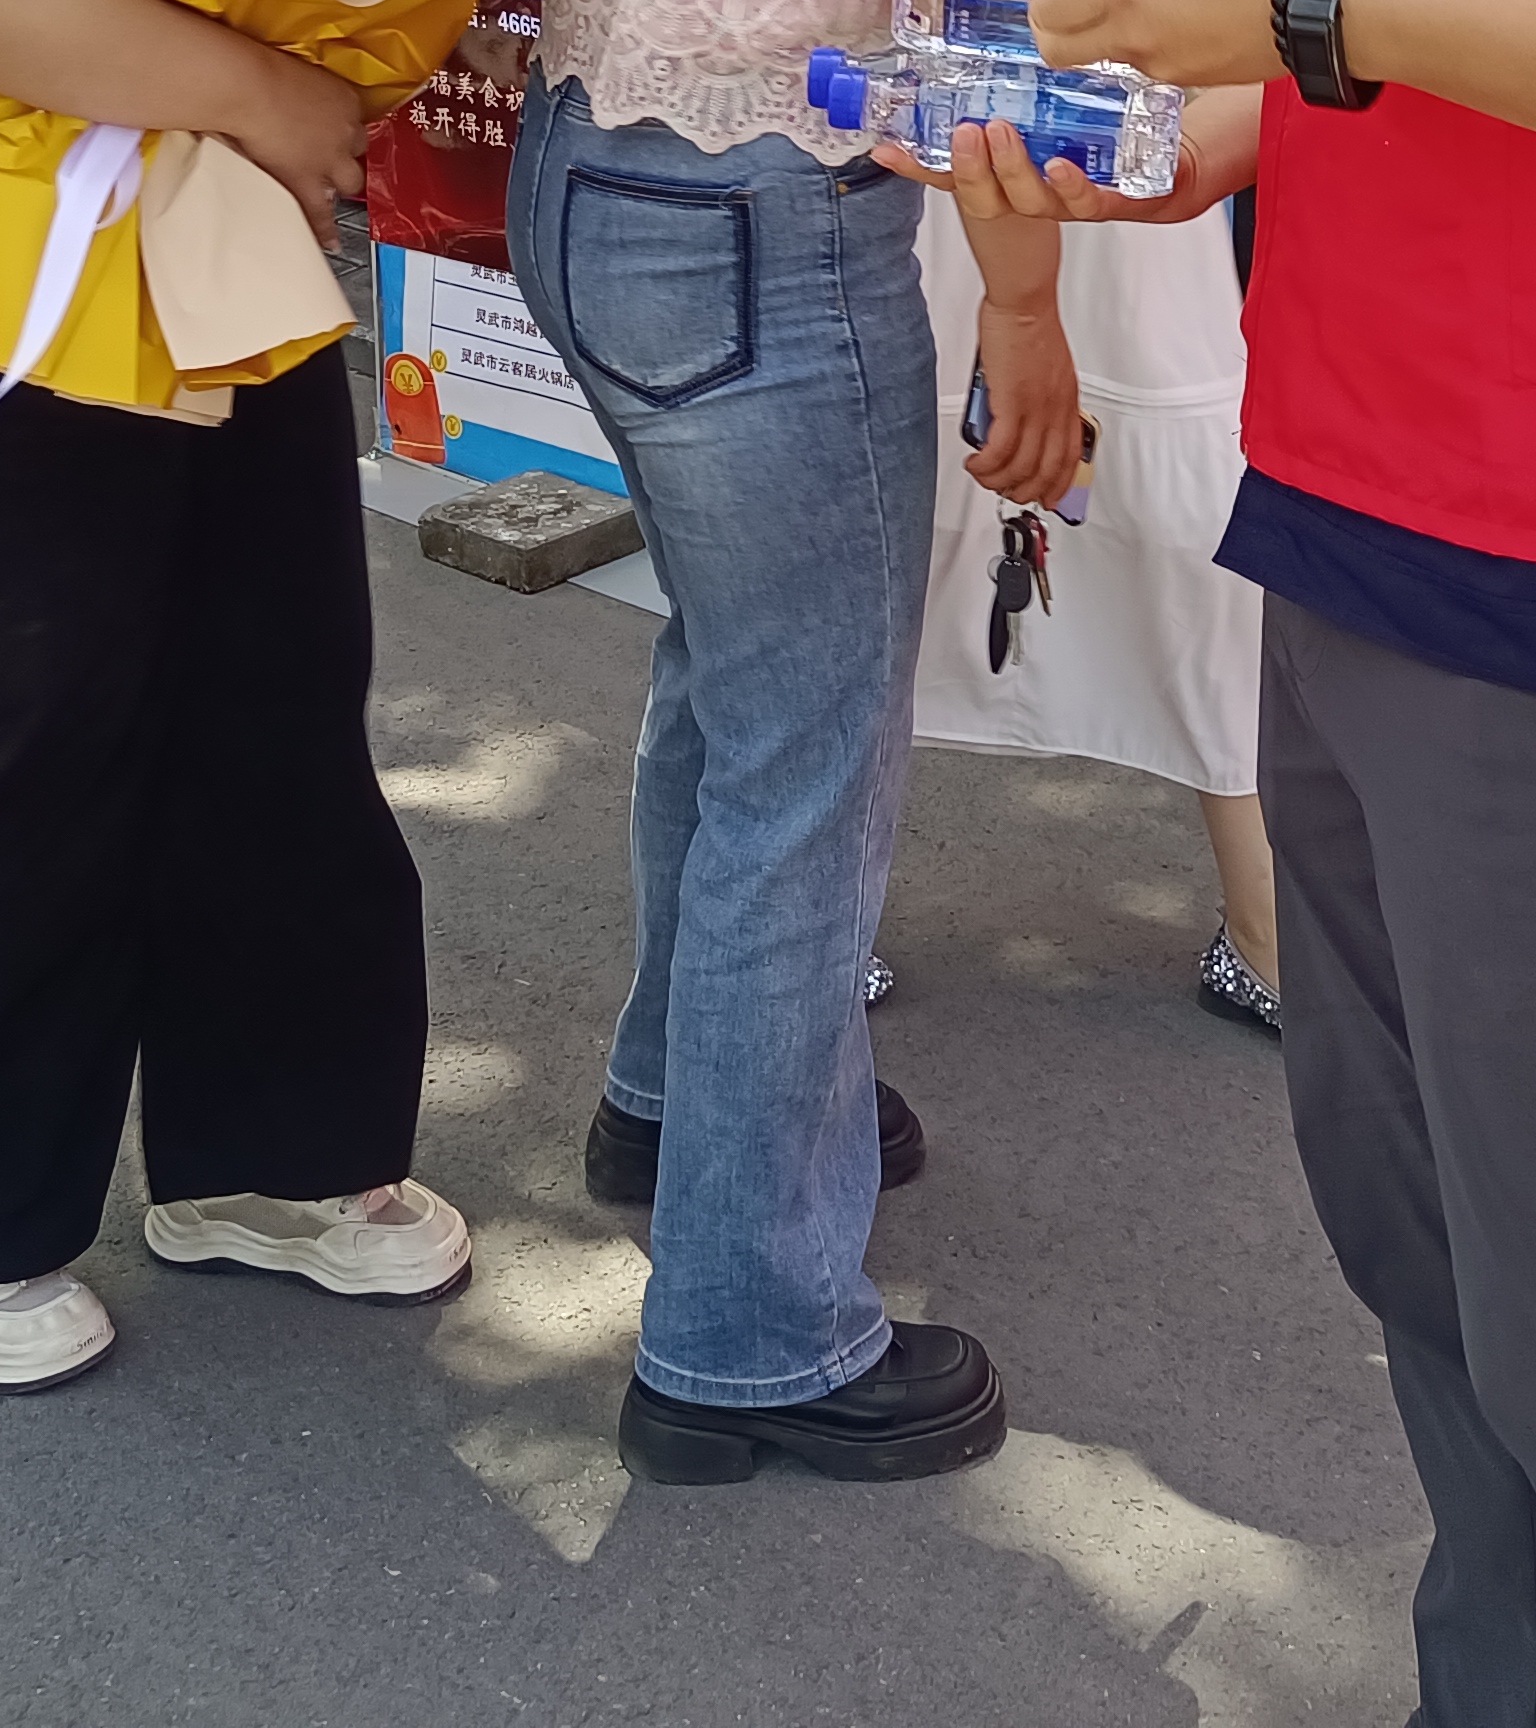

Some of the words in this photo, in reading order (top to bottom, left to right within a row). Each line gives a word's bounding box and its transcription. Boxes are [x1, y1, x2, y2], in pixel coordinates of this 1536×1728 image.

[423, 70, 525, 112] 福美食祝
[460, 347, 575, 391] 灵武市云客居火锅店
